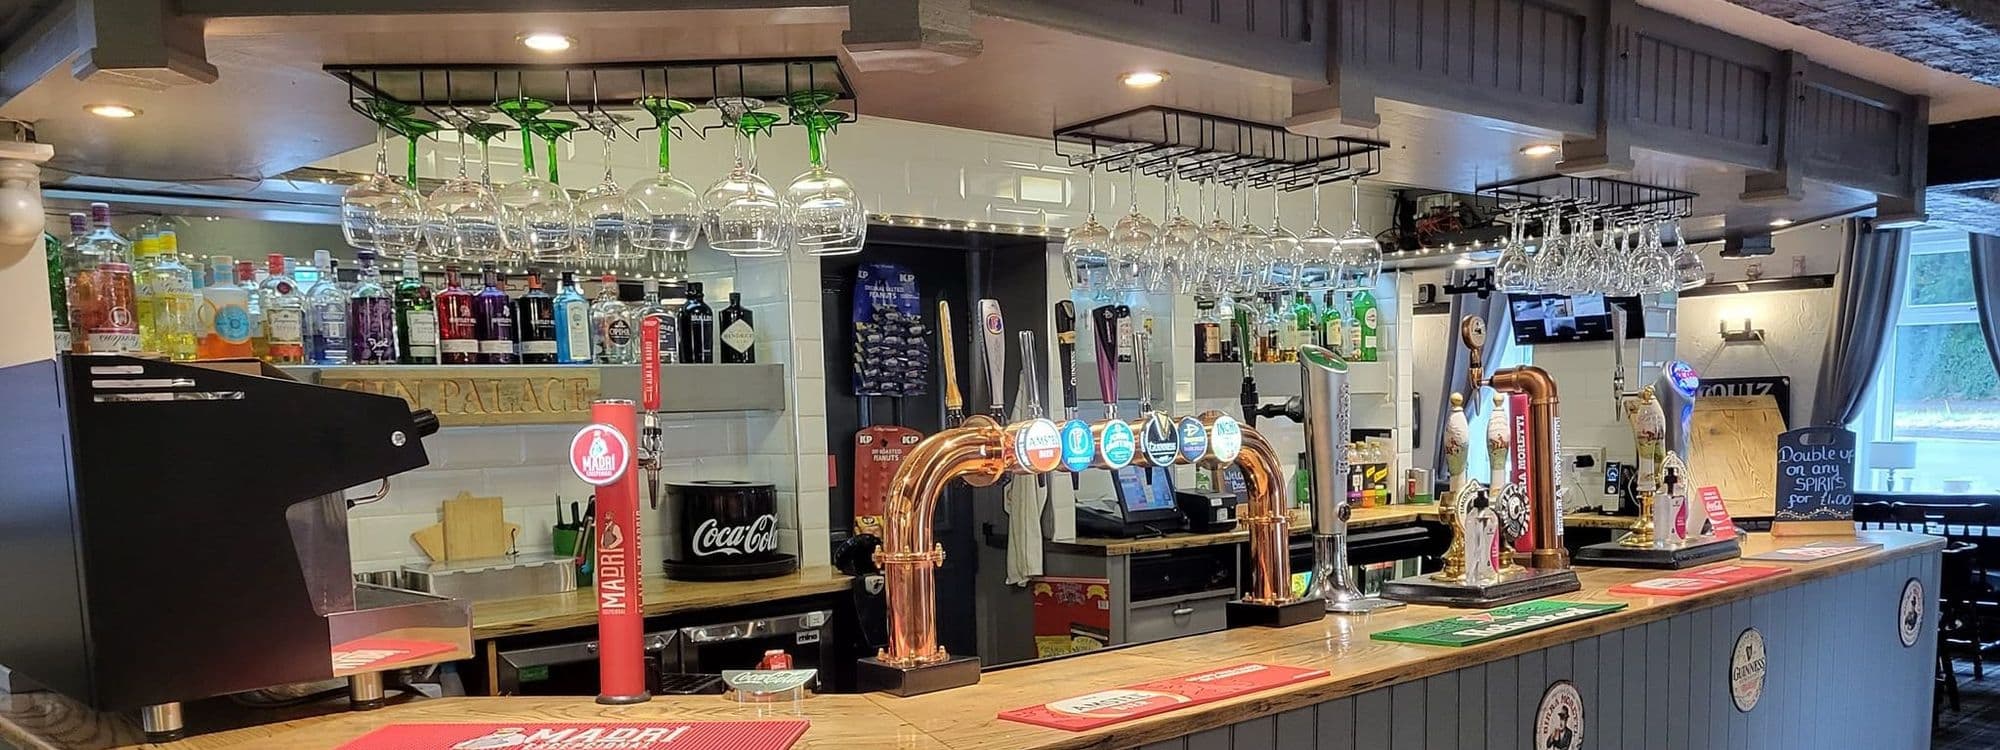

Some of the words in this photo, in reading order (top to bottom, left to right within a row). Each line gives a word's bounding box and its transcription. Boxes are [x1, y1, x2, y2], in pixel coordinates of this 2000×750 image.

[899, 273, 915, 282] KP
[438, 377, 592, 415] PALACE
[859, 435, 873, 444] KP
[902, 435, 919, 444] KP
[1516, 415, 1526, 470] MORETTI
[873, 454, 899, 462] PEANUTS
[1778, 445, 1836, 463] Double
[1785, 465, 1805, 476] on
[1811, 464, 1839, 480] any
[1793, 476, 1847, 492] SPIRITS
[1787, 494, 1813, 509] for
[1820, 491, 1852, 505] £1.00
[692, 513, 778, 557] Coca-Cola
[797, 633, 818, 642] rhino
